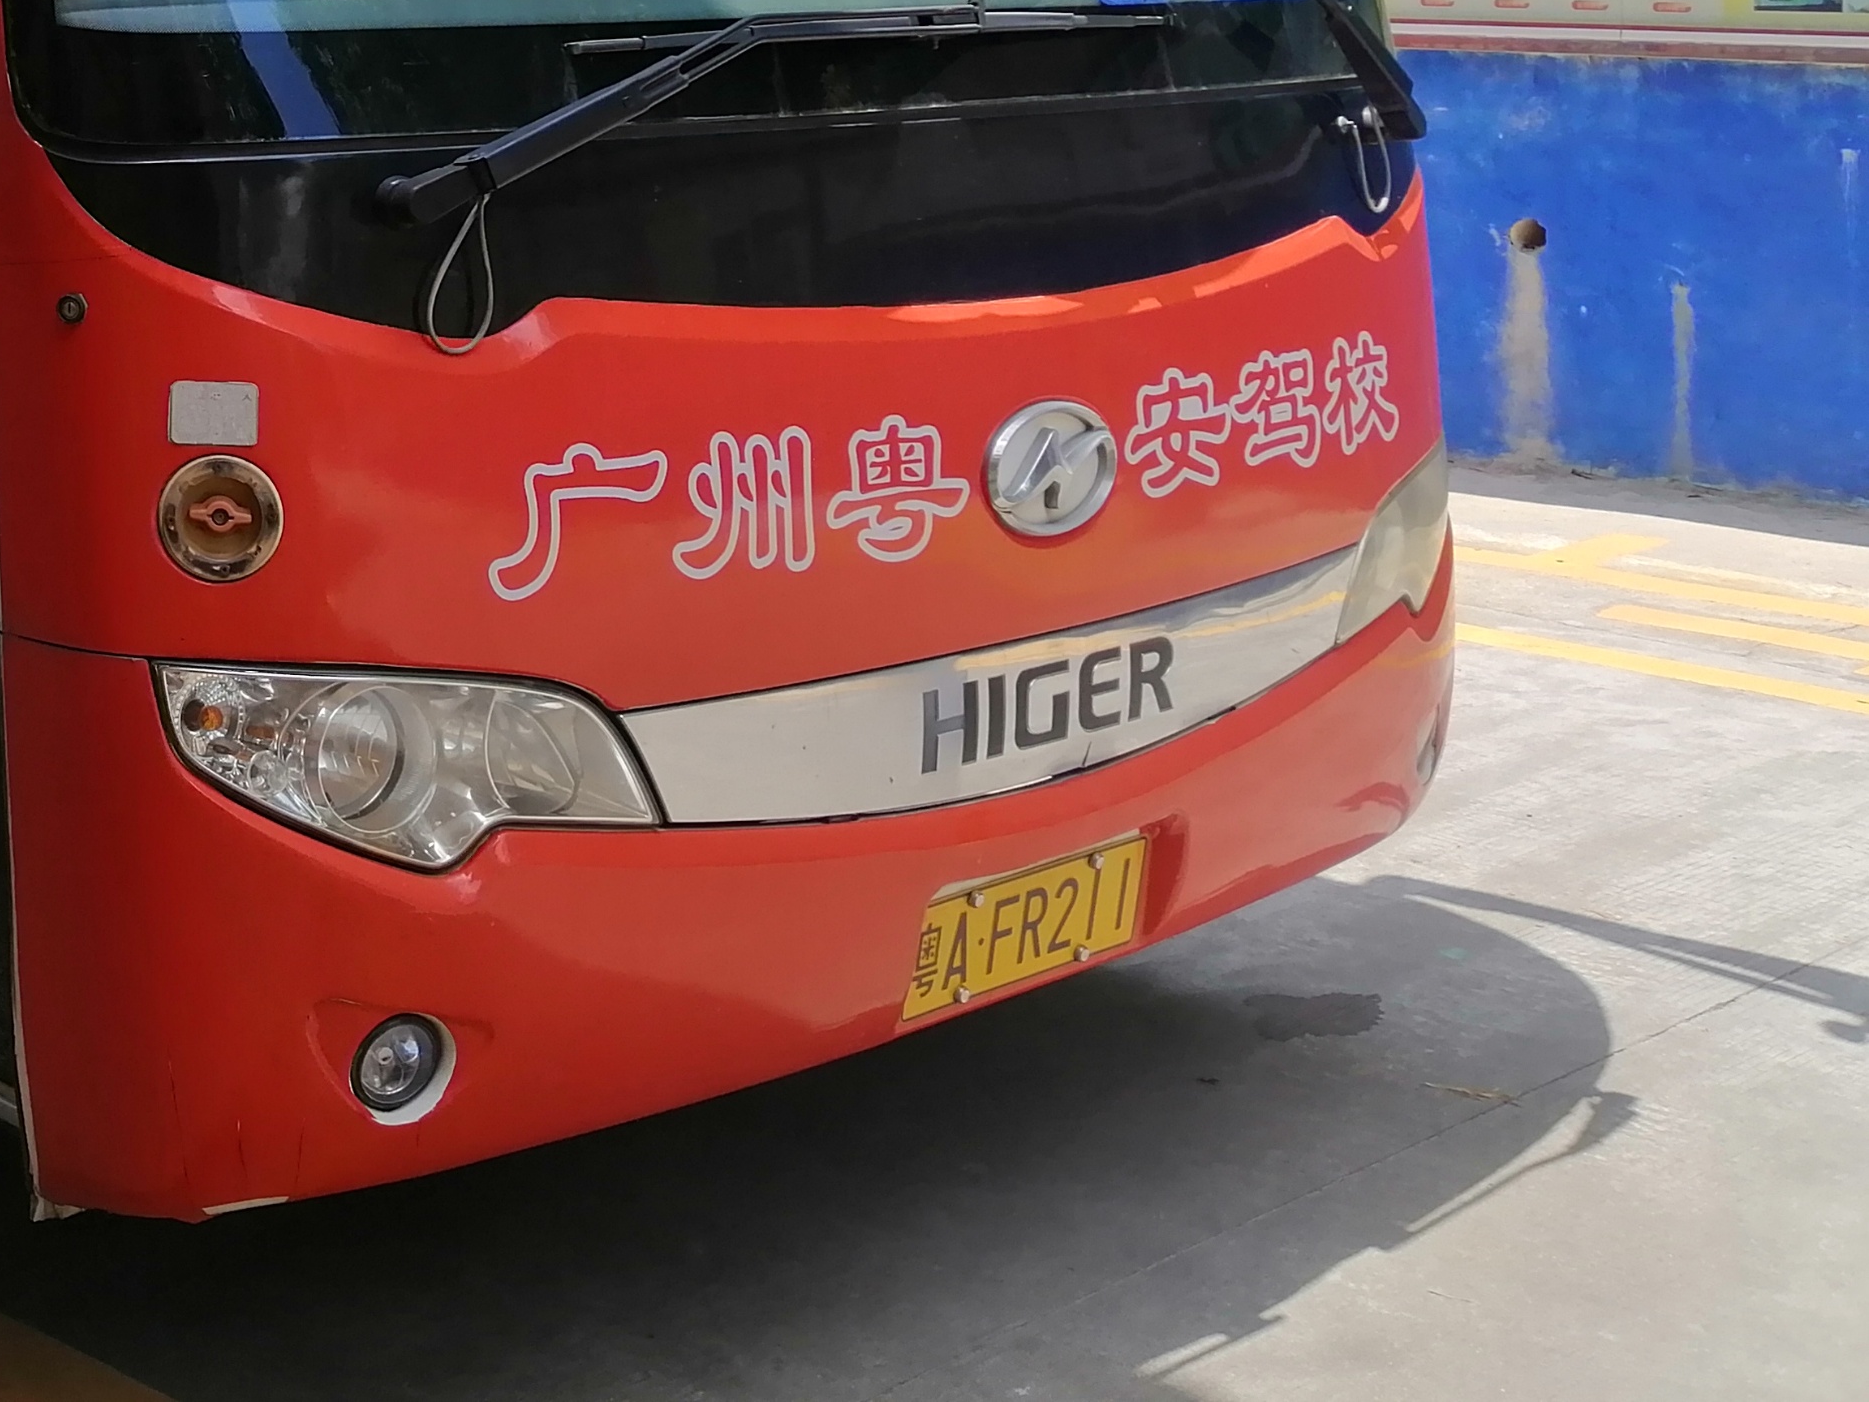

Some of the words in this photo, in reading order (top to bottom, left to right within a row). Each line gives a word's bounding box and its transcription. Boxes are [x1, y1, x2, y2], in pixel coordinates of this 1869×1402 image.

[487, 413, 970, 601] 广州粤
[1124, 330, 1400, 500] 安驾校
[920, 636, 1174, 776] HIGER
